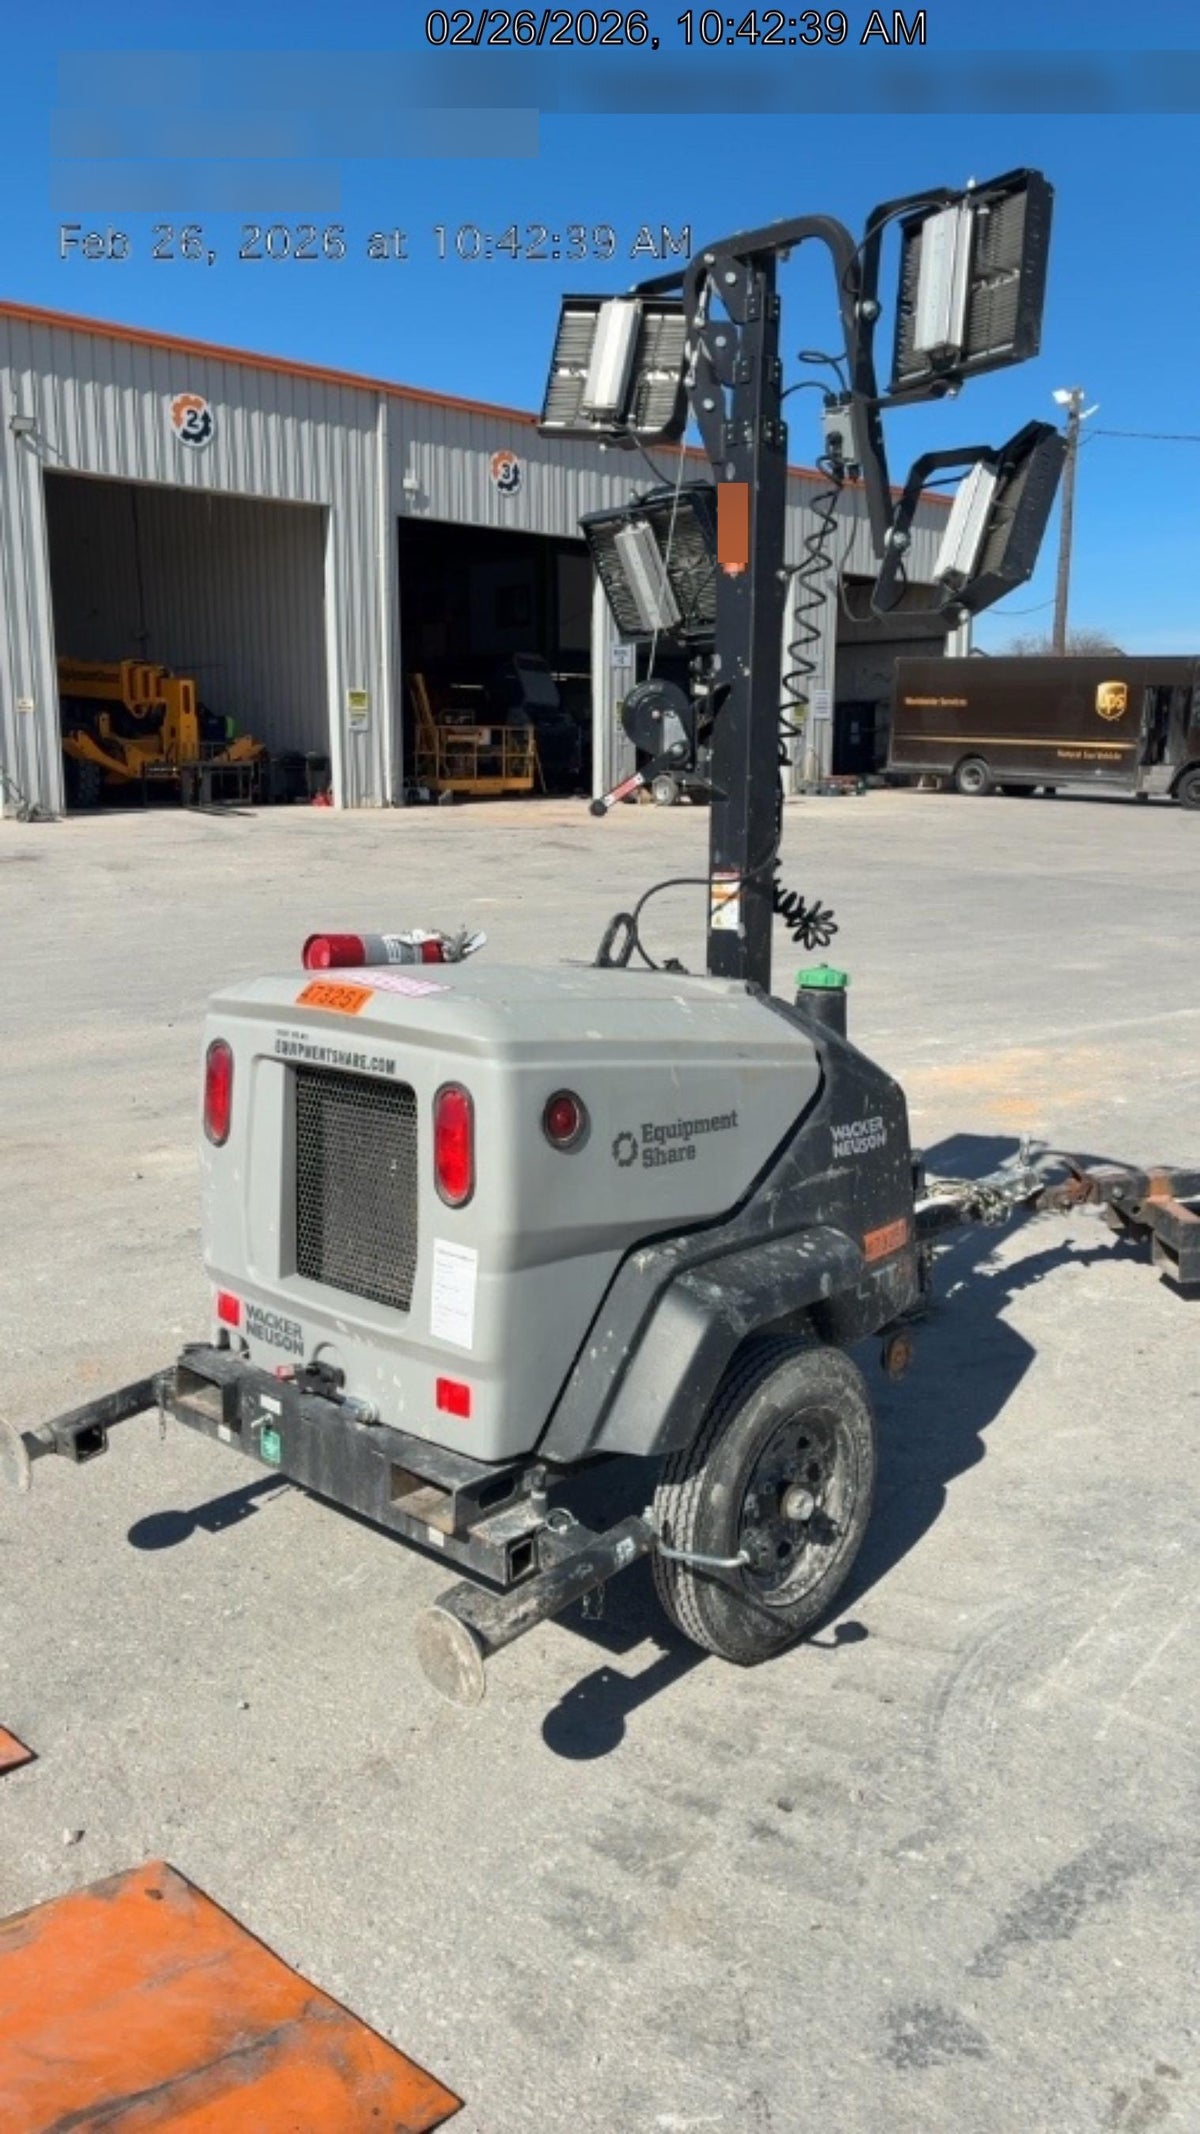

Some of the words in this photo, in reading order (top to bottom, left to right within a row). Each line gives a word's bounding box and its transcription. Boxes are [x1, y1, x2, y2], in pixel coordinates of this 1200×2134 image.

[186, 409, 200, 429] 2
[502, 463, 511, 480] 3
[641, 1109, 739, 1146] Equipment
[829, 1116, 883, 1142] WACKER
[642, 1144, 696, 1169] Share
[832, 1127, 888, 1159] NEUSON
[246, 1303, 302, 1340] WACKER
[246, 1319, 304, 1357] NEUSON
